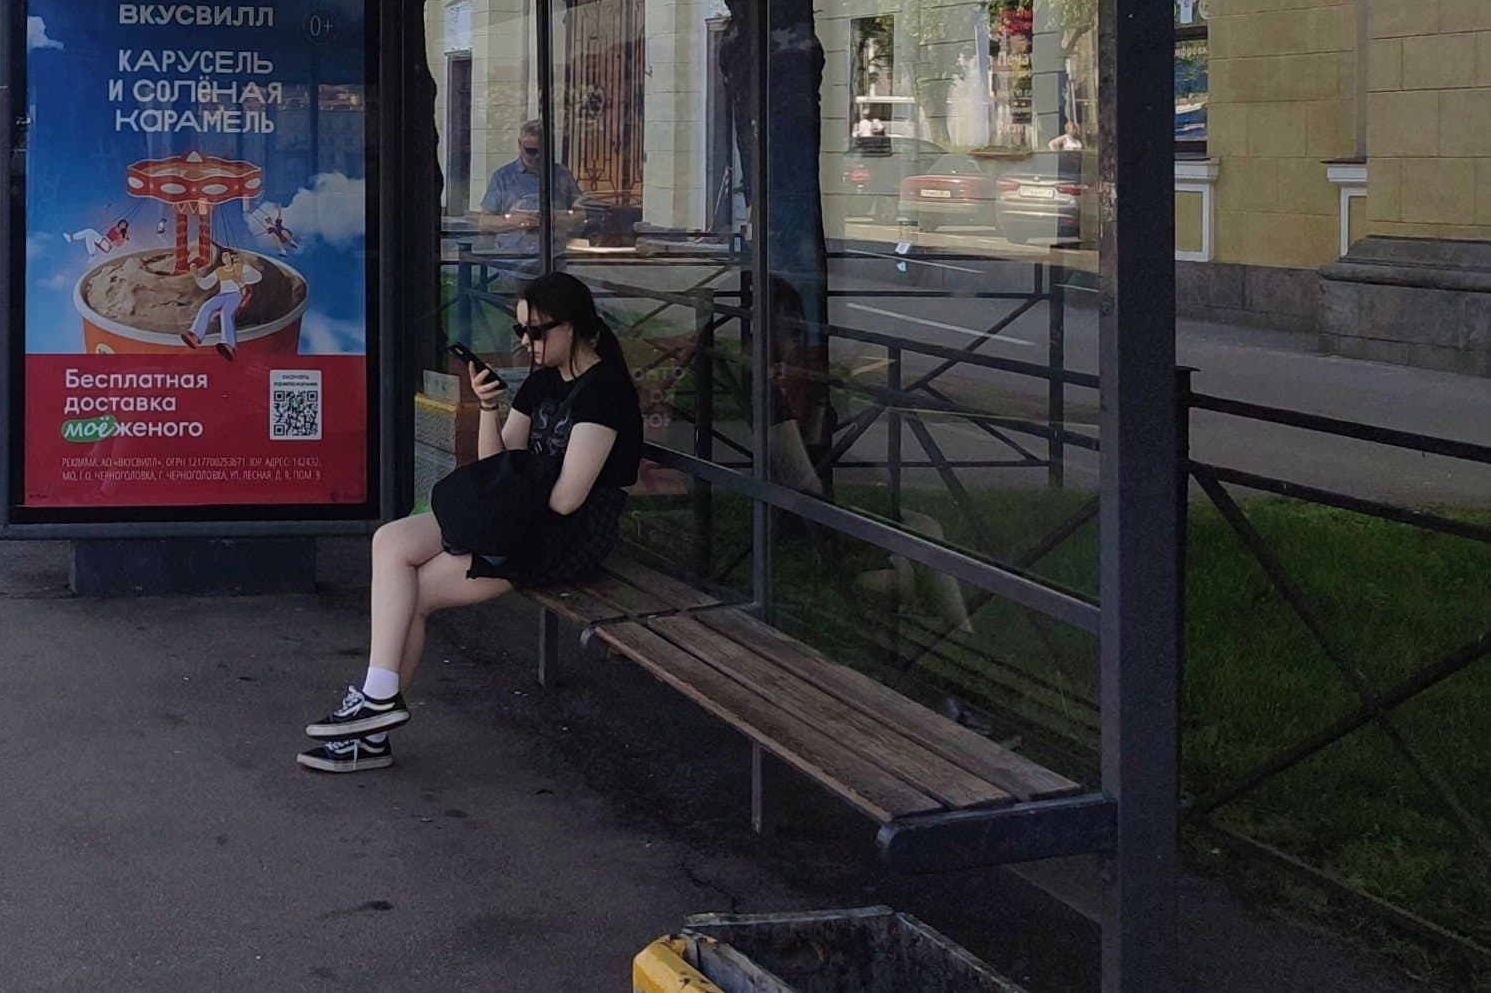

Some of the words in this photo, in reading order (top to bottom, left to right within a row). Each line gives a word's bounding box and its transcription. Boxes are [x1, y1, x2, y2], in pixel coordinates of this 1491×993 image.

[118, 3, 274, 27] ВКУСВИЛЛ
[310, 15, 335, 37] 0+
[118, 48, 274, 74] КАРУСЕЛЬ
[108, 78, 124, 102] И
[115, 109, 275, 133] КАРАМЕЛЬ
[65, 368, 208, 388] Бесплатная
[64, 396, 176, 414] доставка
[63, 416, 203, 437] моёженого
